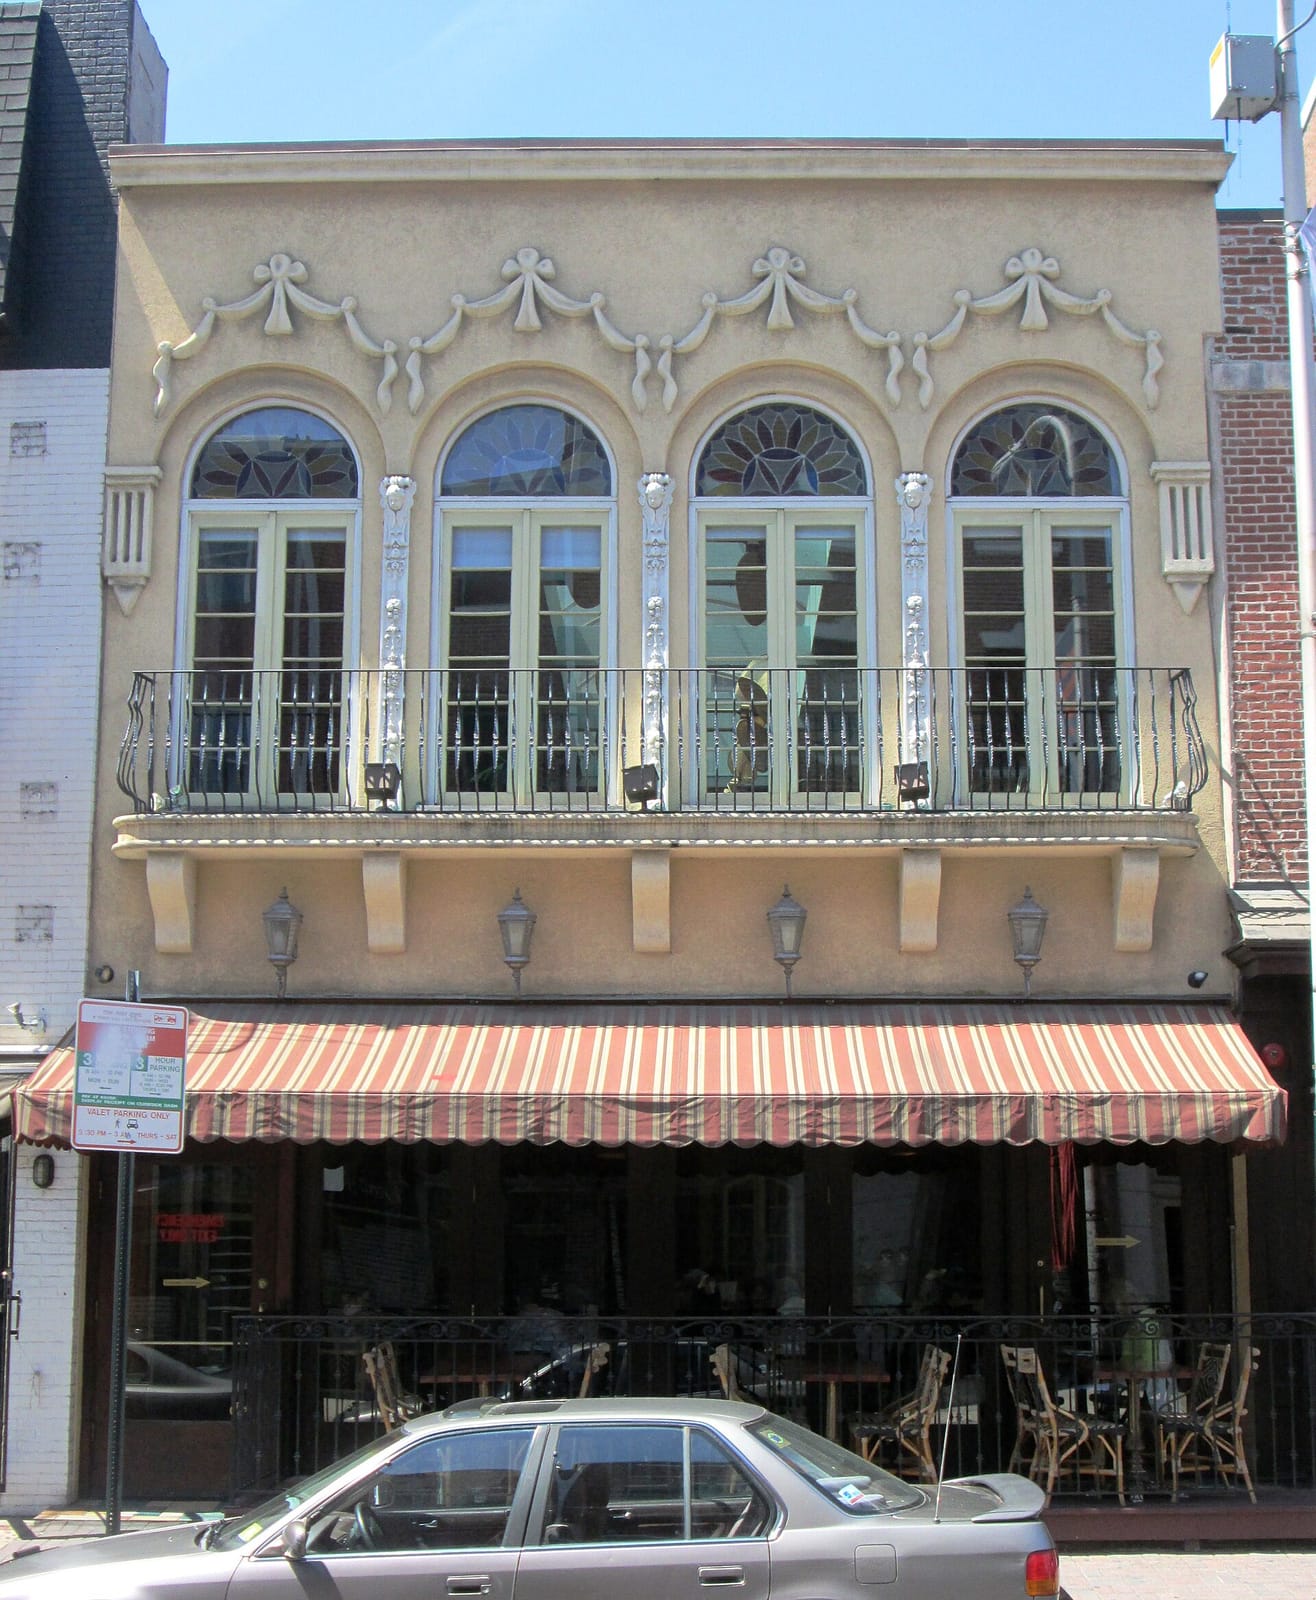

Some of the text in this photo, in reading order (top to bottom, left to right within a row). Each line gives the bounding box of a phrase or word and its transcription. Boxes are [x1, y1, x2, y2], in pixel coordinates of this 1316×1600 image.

[83, 1052, 93, 1066] 3
[135, 1056, 145, 1070] 3
[149, 1064, 181, 1073] PARKING
[87, 1107, 170, 1120] VALET PARKING ONLY
[96, 1129, 107, 1137] PM
[120, 1131, 132, 1139] AM
[137, 1132, 159, 1140] THURS
